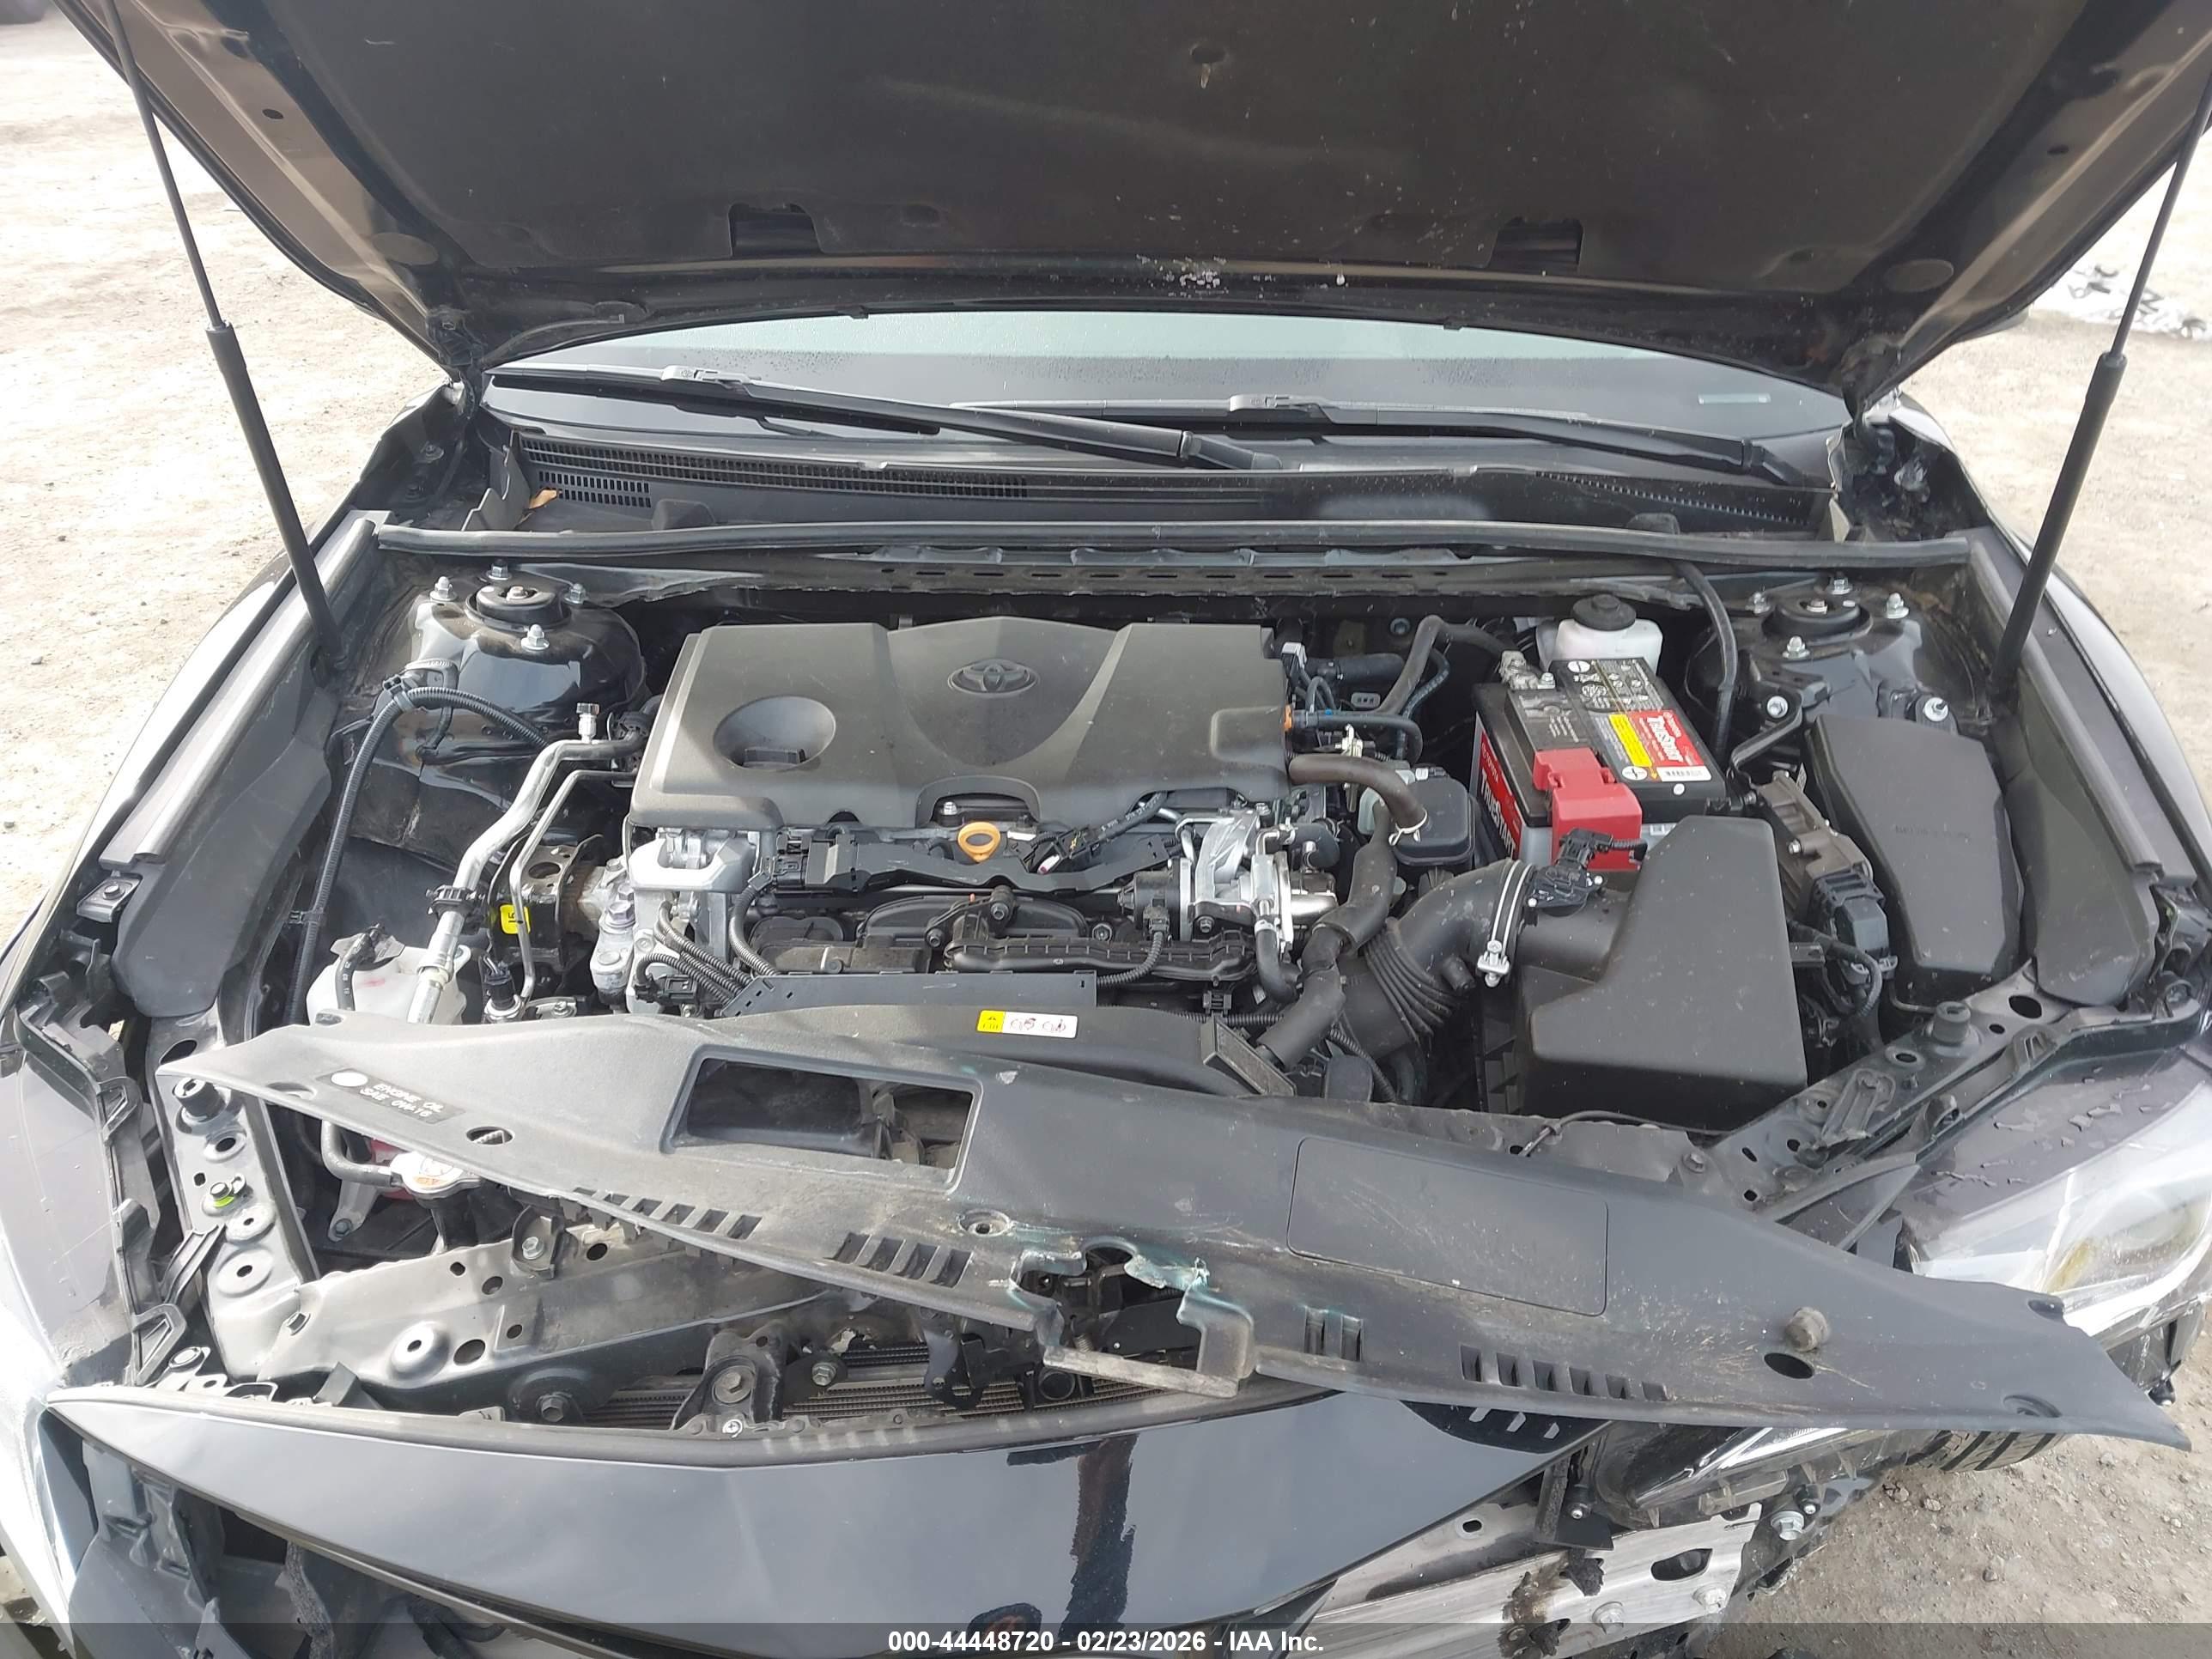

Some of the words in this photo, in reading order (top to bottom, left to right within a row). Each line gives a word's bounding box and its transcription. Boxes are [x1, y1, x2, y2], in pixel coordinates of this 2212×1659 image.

[1480, 769, 1516, 860] TRUESTART
[360, 1087, 389, 1101] SAE
[391, 1099, 433, 1117] 0W-16
[374, 1083, 422, 1103] ENGINE
[423, 1102, 444, 1113] OIL
